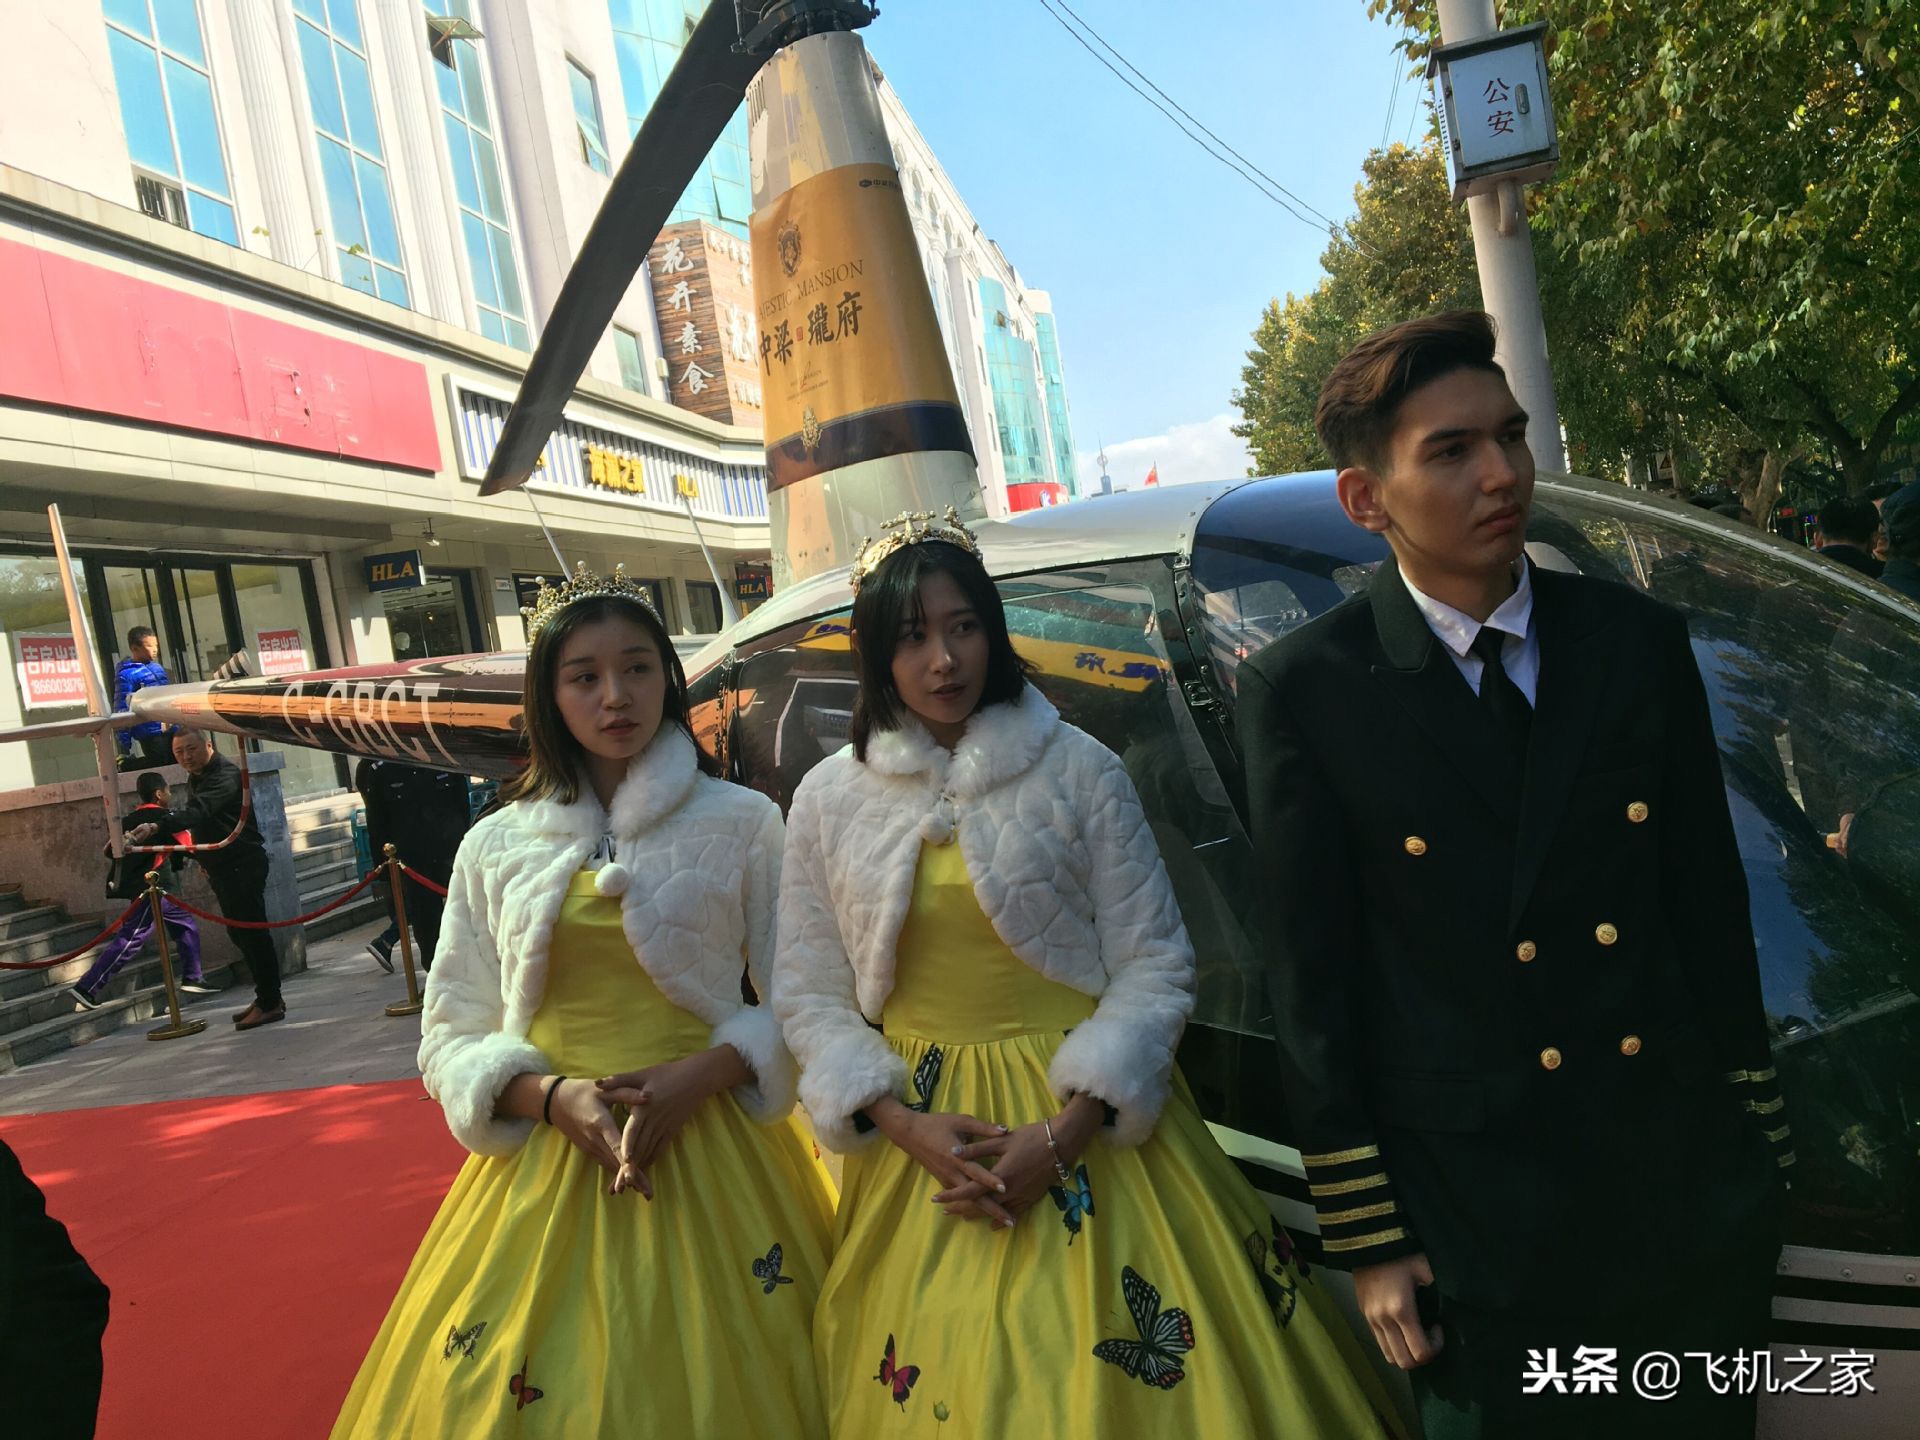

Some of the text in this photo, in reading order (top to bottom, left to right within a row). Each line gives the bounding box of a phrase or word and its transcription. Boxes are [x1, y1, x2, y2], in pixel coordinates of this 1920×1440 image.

[1483, 77, 1515, 138] 公安
[796, 259, 864, 300] MANSION
[661, 238, 715, 395] 花开素食
[371, 560, 416, 582] HLA
[739, 582, 764, 594] HLA
